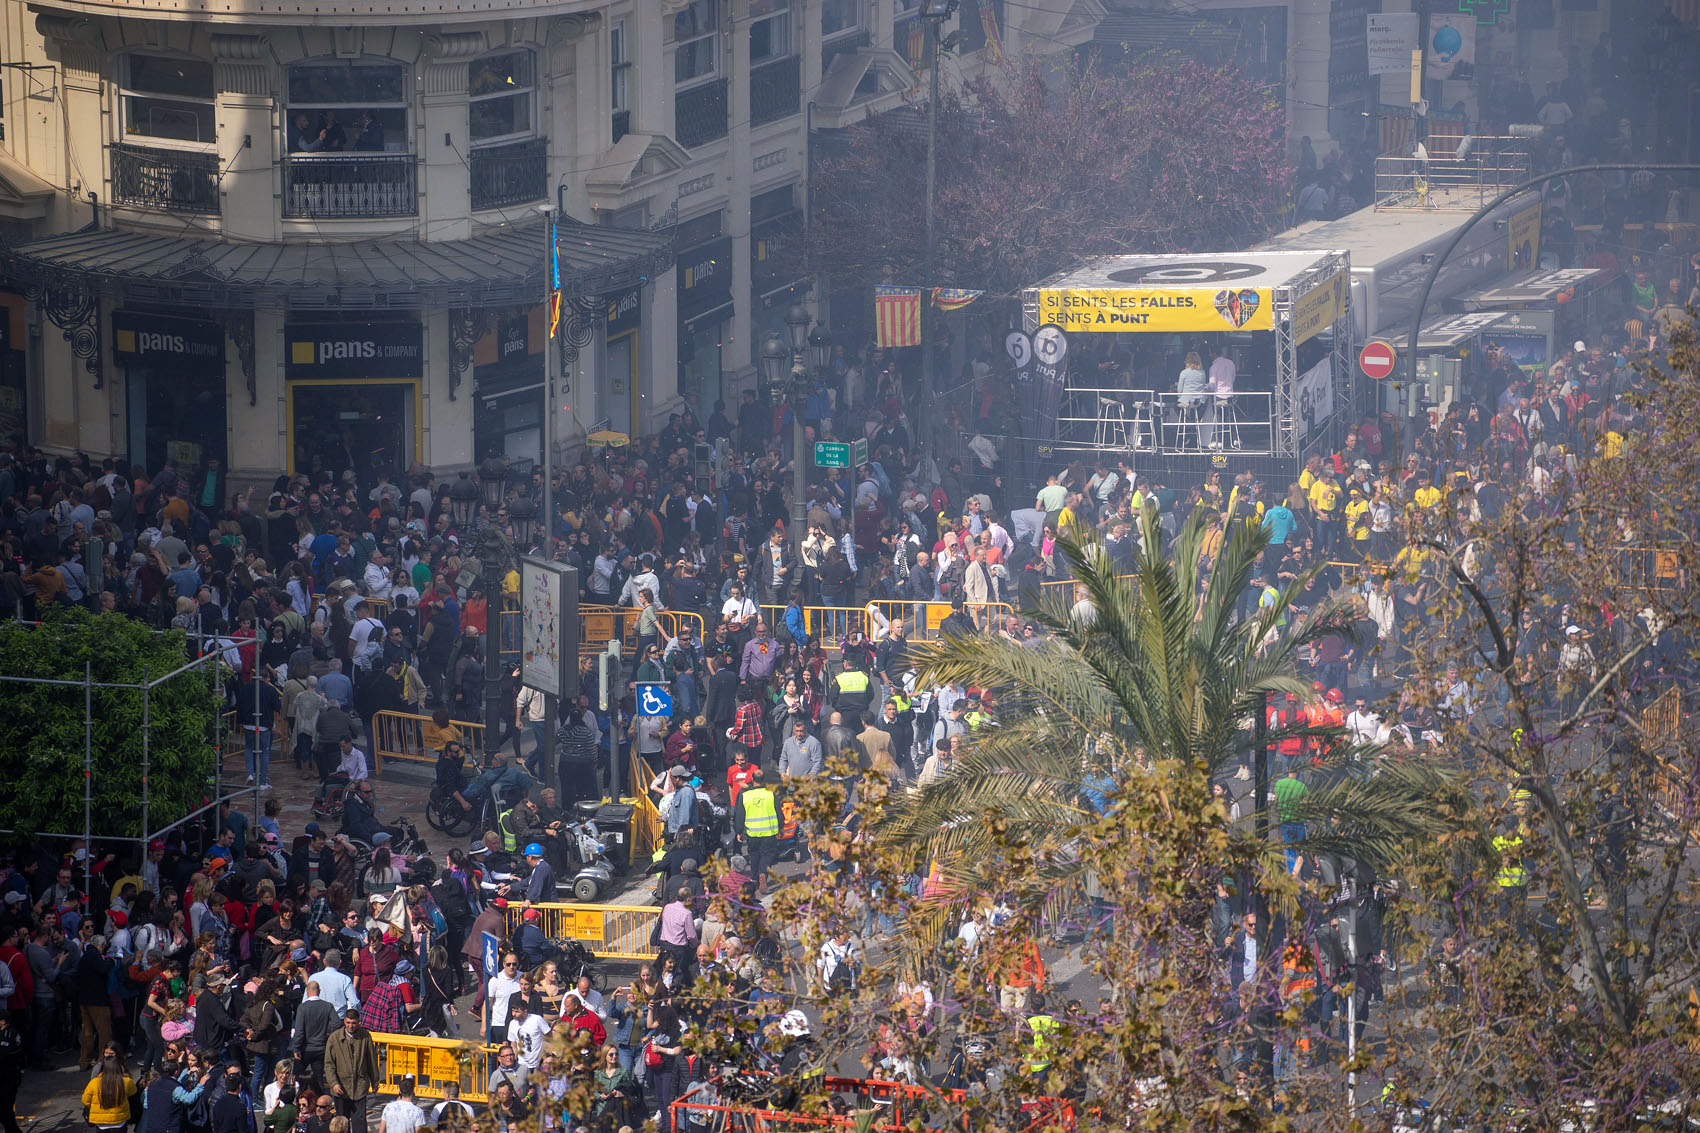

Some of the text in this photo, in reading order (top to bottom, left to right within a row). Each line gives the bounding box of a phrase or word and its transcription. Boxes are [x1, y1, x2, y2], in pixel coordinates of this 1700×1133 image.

[694, 260, 714, 287] pans
[1047, 296, 1198, 310] SI SENTS LES FALLES,
[1047, 309, 1150, 325] SENTS À PUNT
[139, 330, 184, 354] pans
[504, 339, 524, 357] pans
[320, 340, 418, 365] pans & COMPANY
[1038, 446, 1054, 454] SPV
